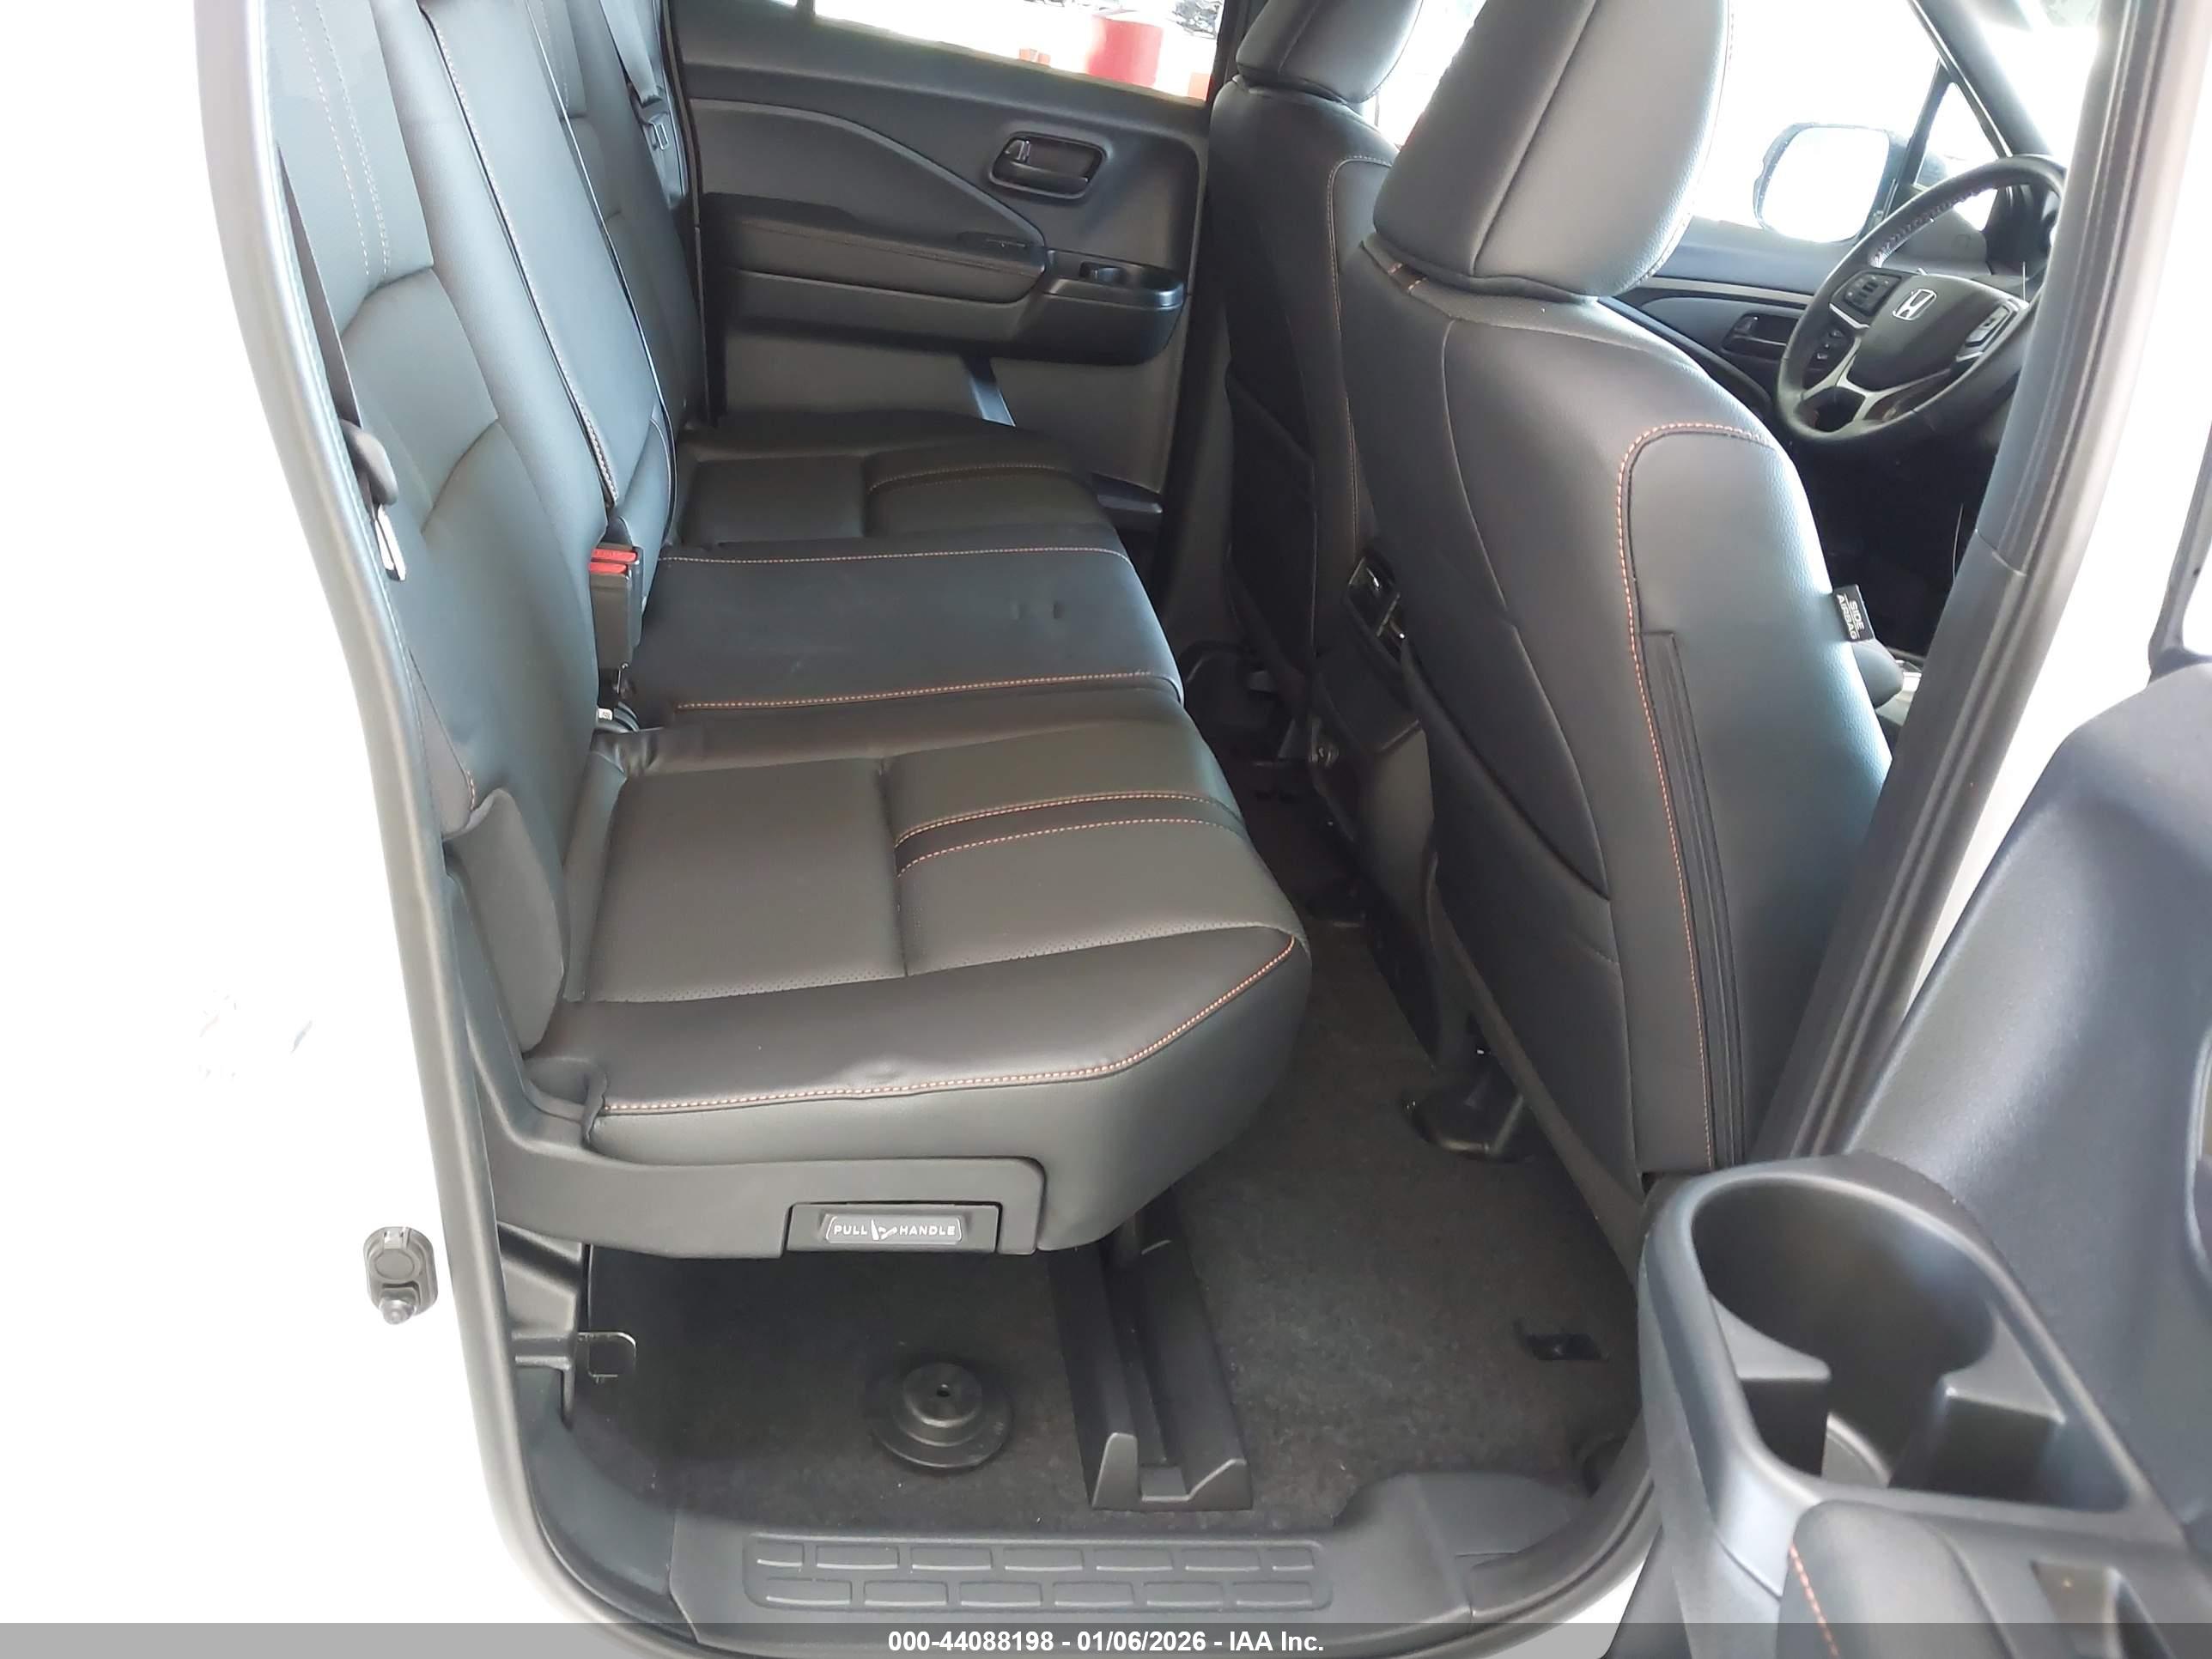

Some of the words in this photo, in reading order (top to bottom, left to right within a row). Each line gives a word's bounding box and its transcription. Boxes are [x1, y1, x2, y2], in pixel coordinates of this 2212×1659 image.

[1836, 593, 1857, 640] AIRBAG
[1849, 600, 1865, 630] SIDE
[833, 1224, 867, 1236] PULL
[899, 1224, 956, 1236] HANDLE
